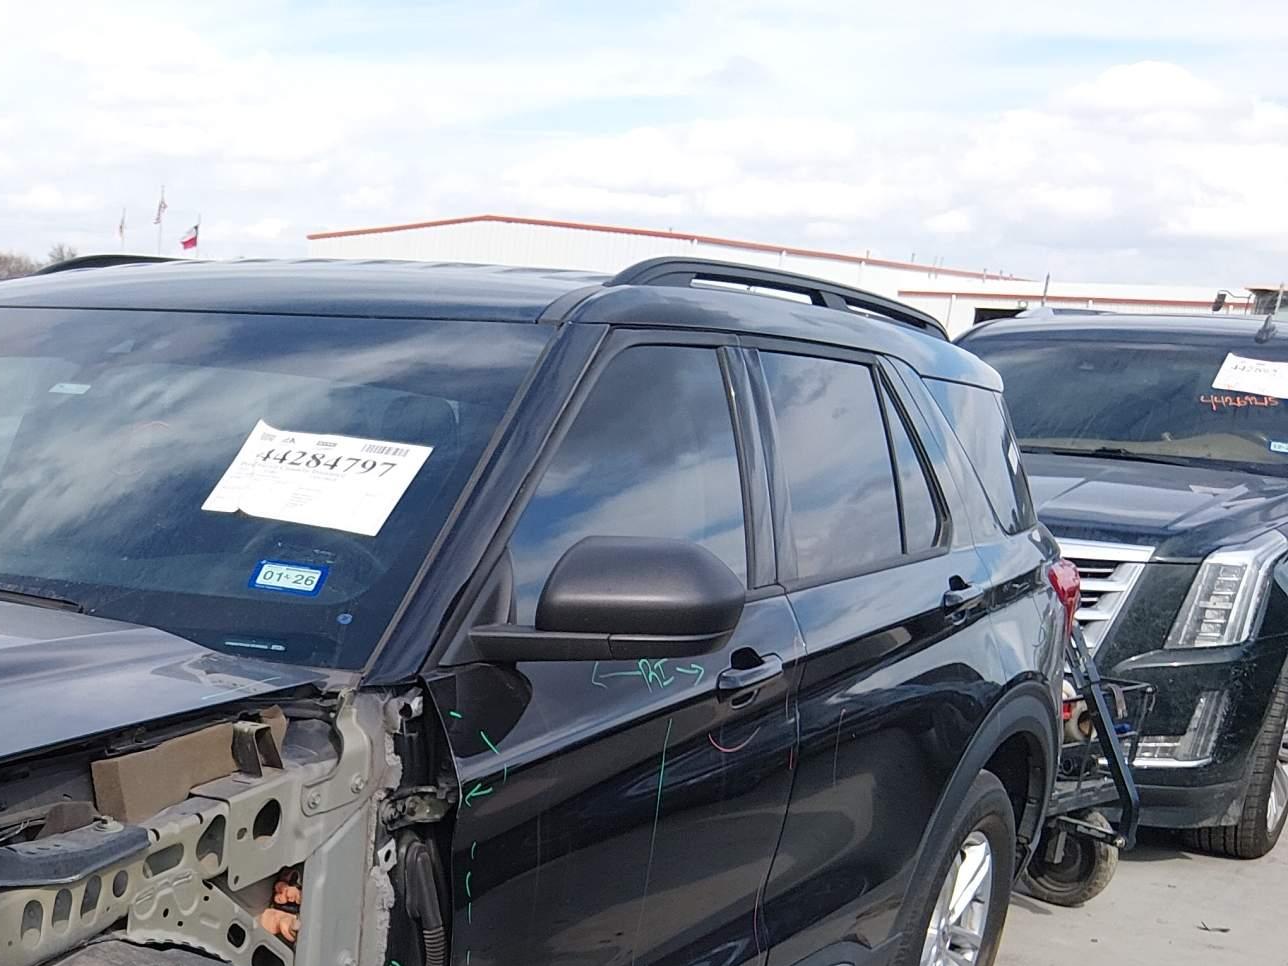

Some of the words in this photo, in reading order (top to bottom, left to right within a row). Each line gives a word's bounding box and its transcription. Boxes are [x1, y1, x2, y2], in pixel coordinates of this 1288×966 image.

[256, 448, 398, 478] 44284797
[263, 570, 284, 583] 01
[292, 573, 316, 586] 26
